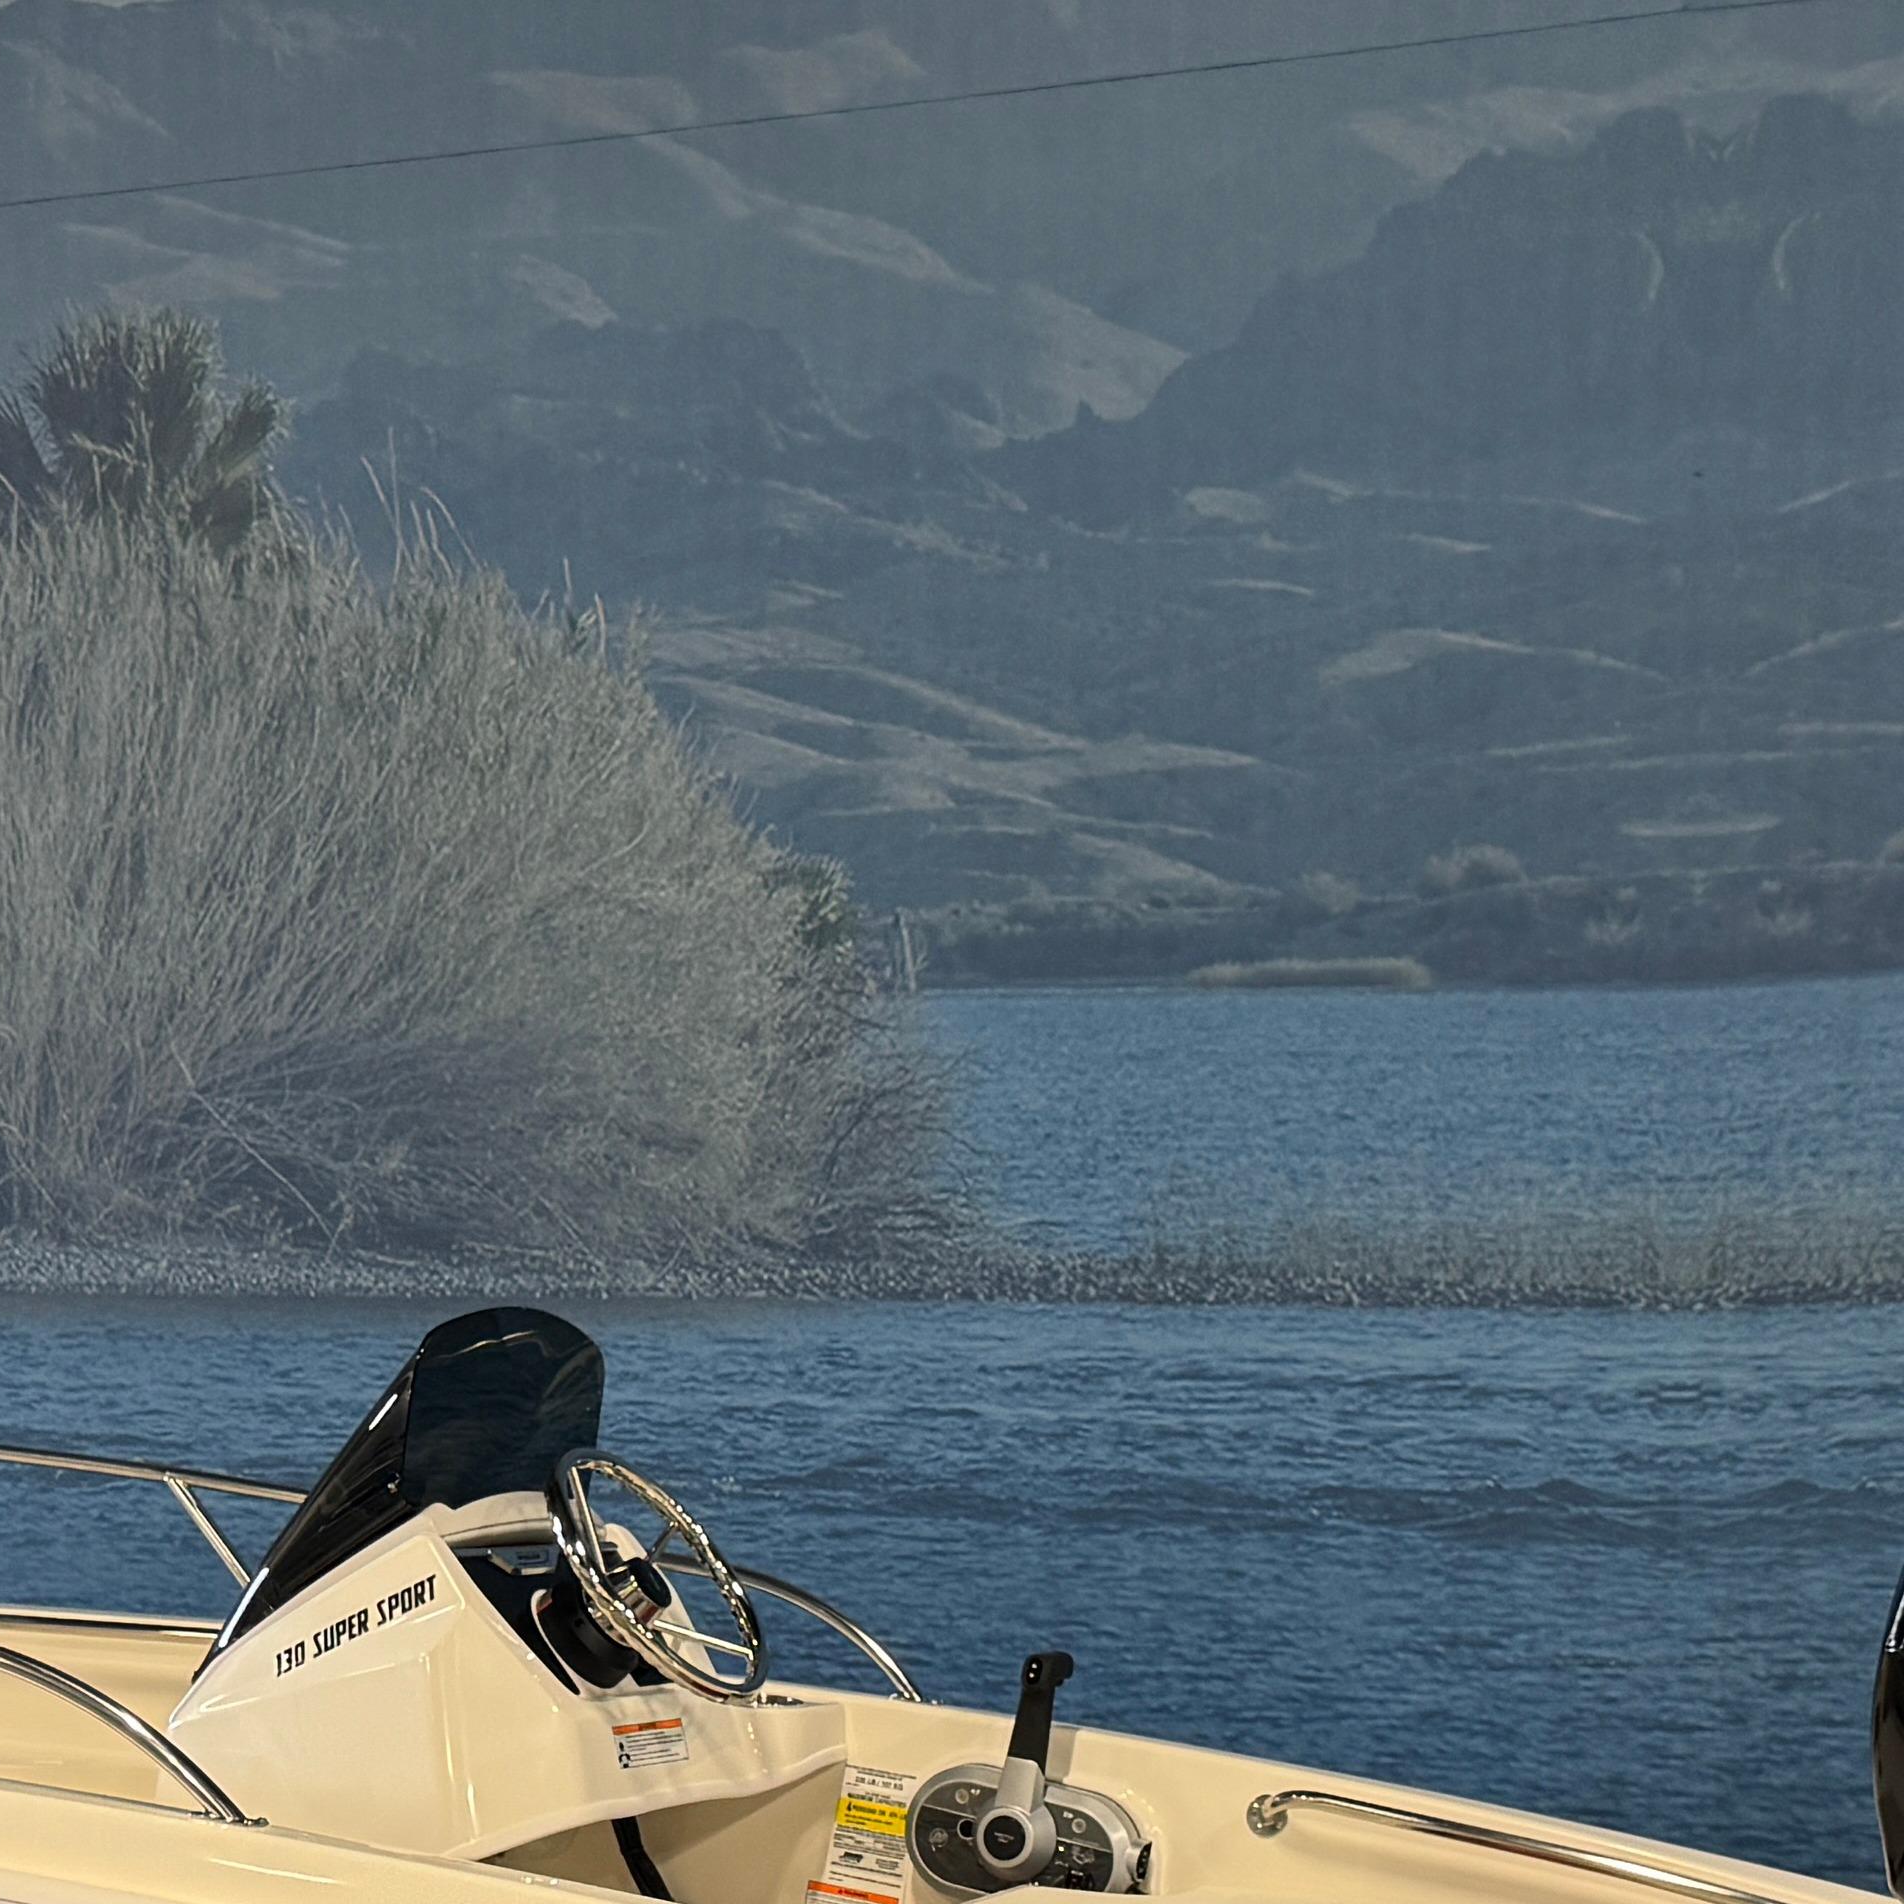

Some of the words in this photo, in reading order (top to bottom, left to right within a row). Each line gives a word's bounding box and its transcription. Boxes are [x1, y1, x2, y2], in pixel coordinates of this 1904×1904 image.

[276, 1640, 305, 1677] 130
[312, 1607, 369, 1659] SUPER
[376, 1574, 437, 1626] SPORT
